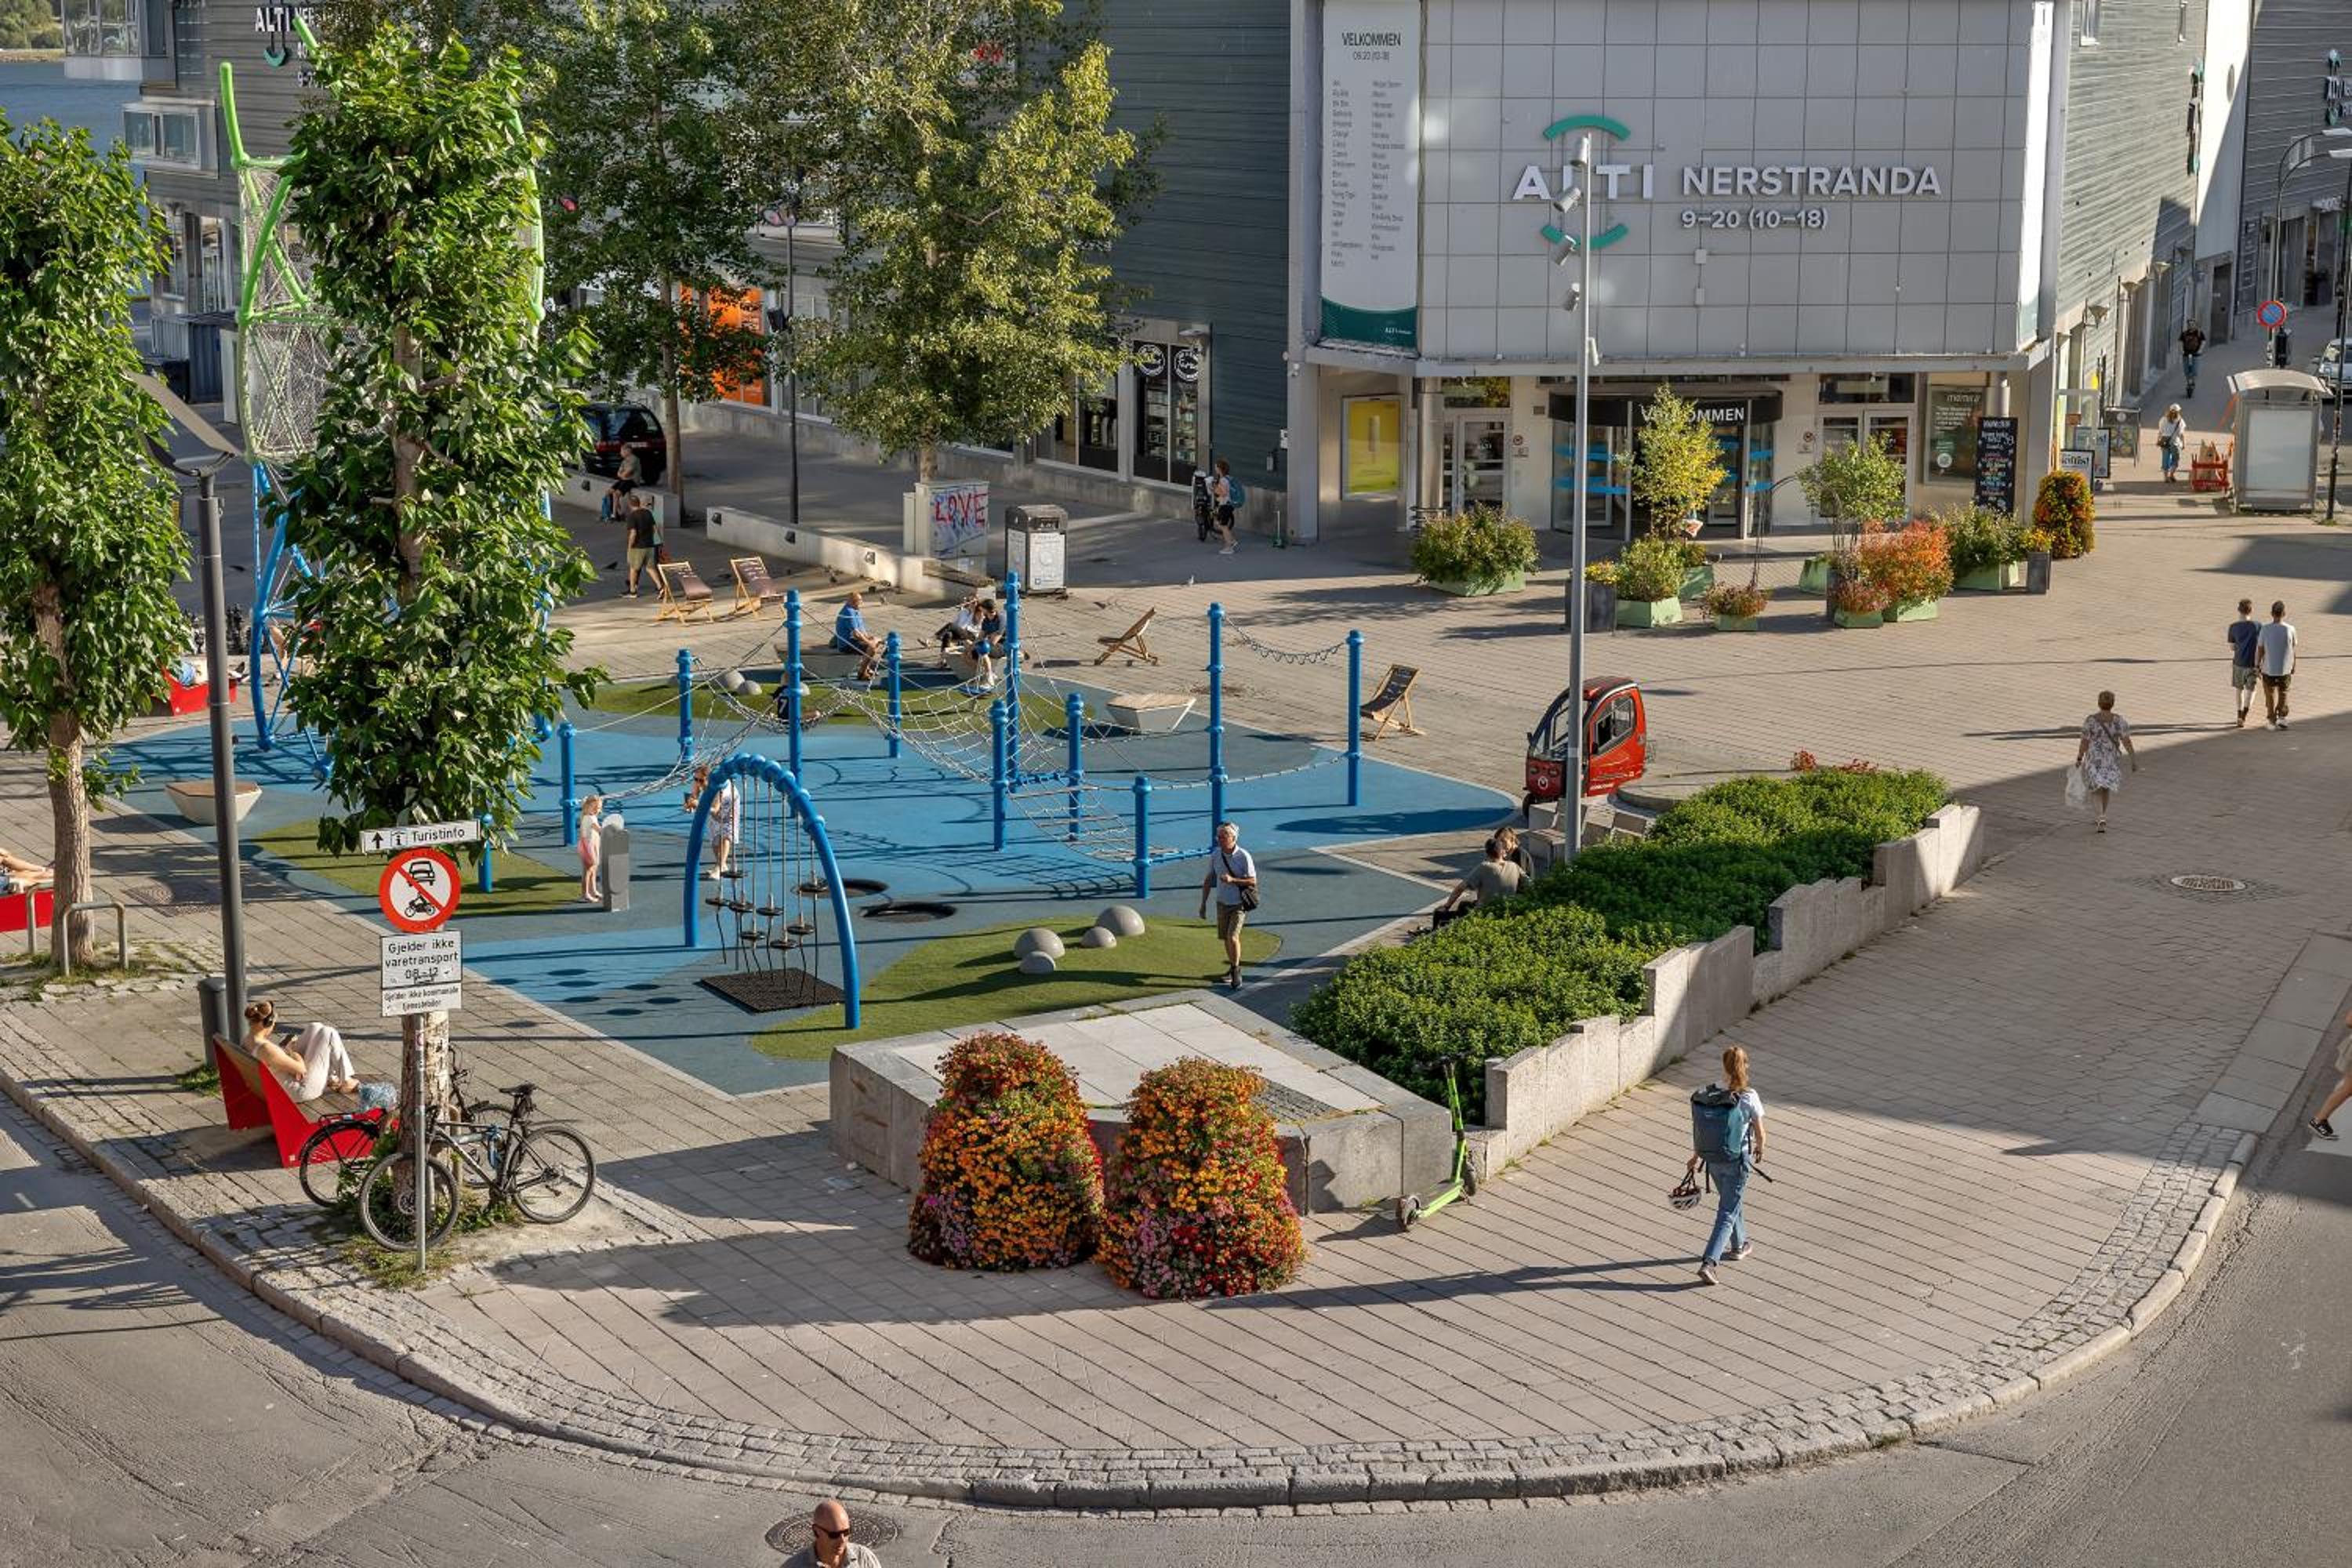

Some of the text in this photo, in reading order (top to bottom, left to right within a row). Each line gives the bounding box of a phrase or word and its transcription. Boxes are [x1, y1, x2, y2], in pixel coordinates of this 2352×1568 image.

[255, 7, 290, 32] ALTI
[1341, 32, 1401, 46] VELKOMMEN
[1682, 166, 1942, 196] NERSTRANDA
[1682, 208, 1829, 230] 9-20 (10-18)
[935, 493, 989, 525] LOVE
[412, 827, 465, 842] Turistinfo
[388, 938, 454, 955] Gjelder ikke
[385, 951, 459, 967] varetransport
